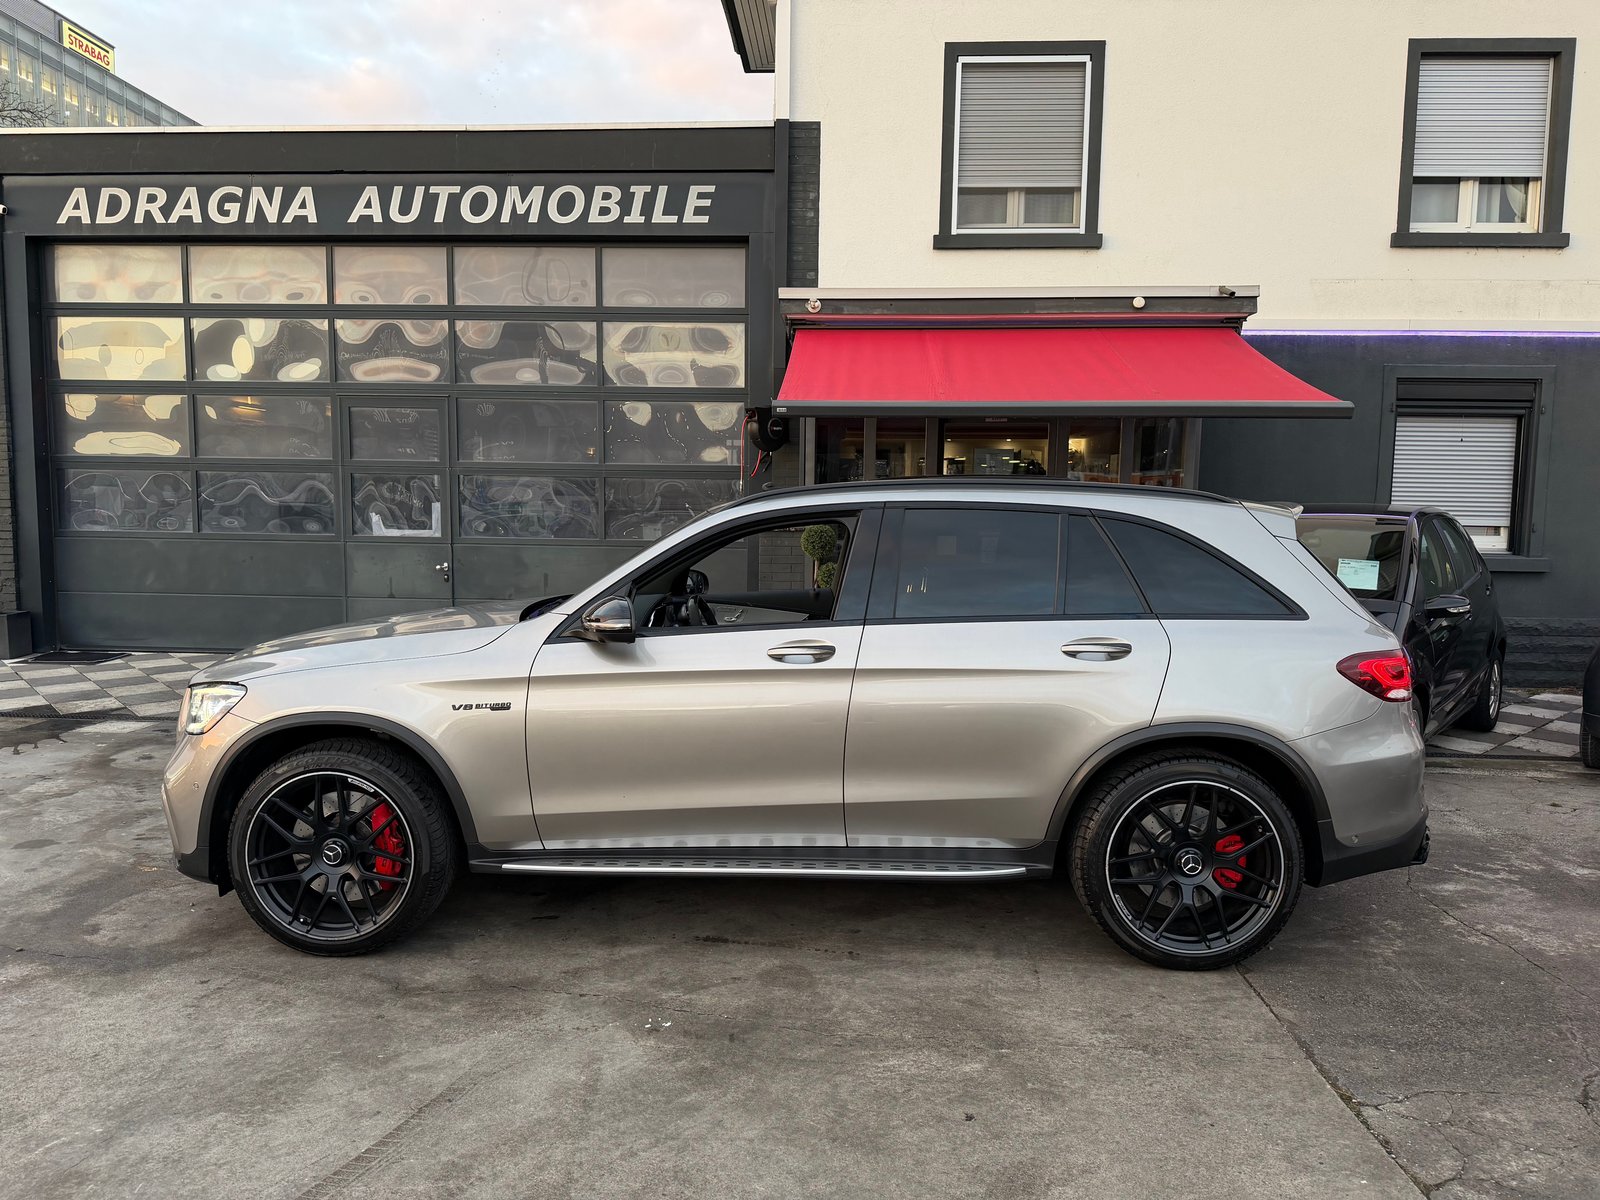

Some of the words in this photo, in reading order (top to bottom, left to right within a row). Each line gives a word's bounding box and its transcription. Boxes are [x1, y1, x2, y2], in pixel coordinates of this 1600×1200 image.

[68, 33, 110, 66] STRABAG
[56, 186, 318, 224] ADRAGNA
[347, 184, 716, 224] AUTOMOBILE
